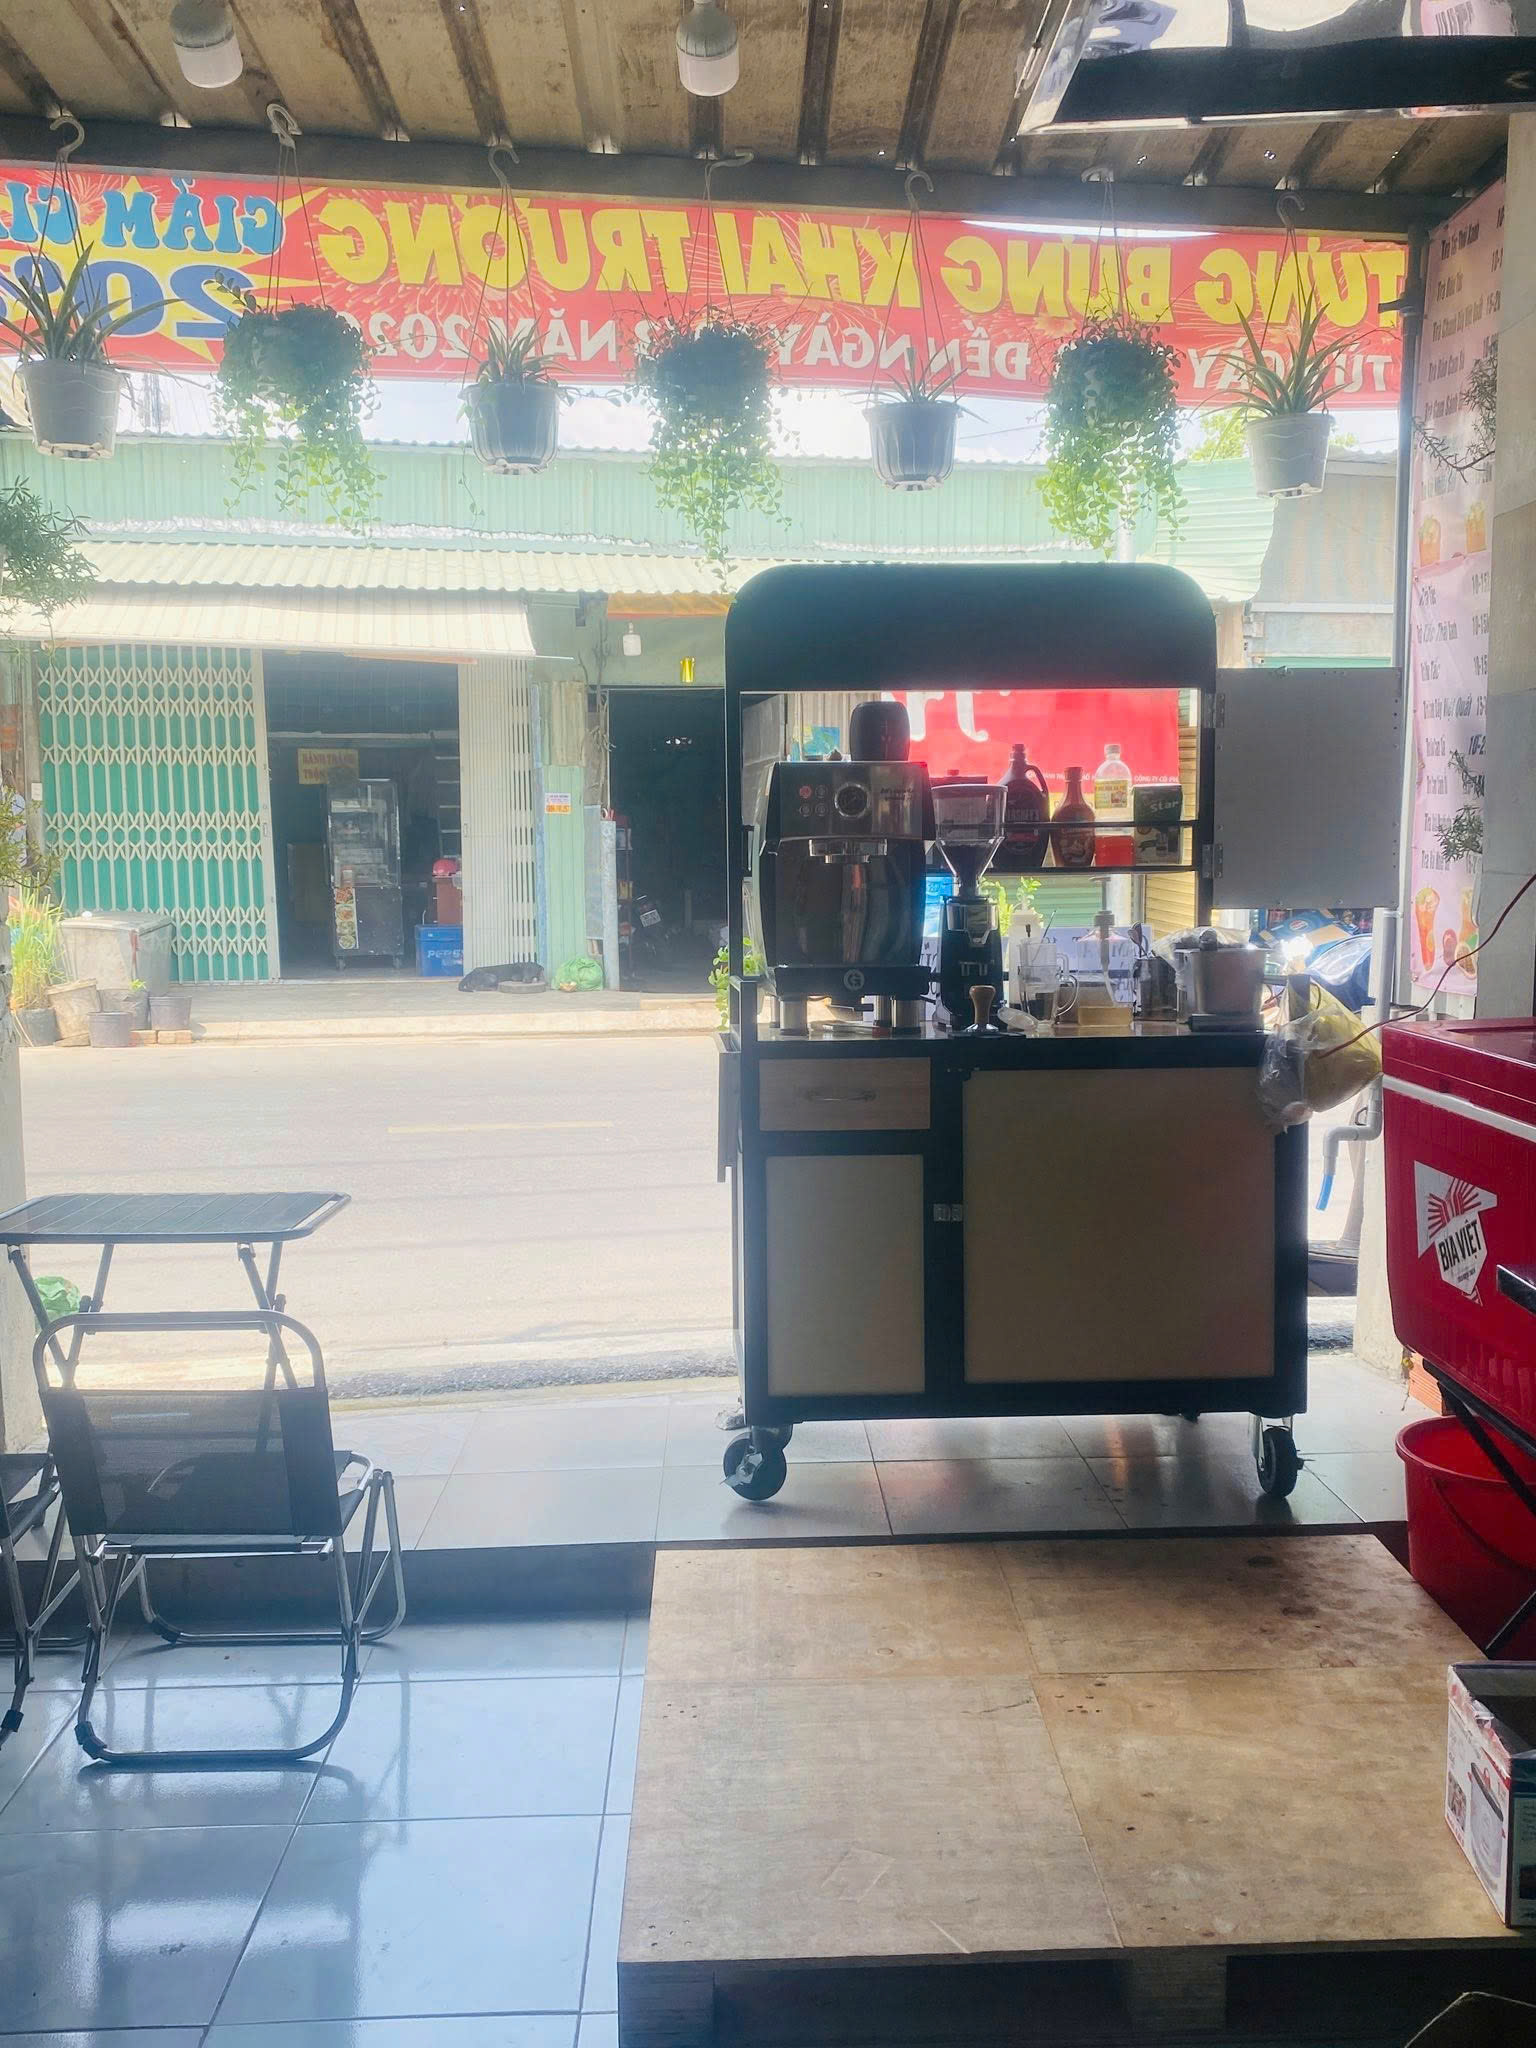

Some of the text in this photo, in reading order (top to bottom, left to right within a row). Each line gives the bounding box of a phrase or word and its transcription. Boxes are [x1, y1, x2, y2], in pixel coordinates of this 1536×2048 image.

[427, 949, 464, 959] PEPS
[1438, 1218, 1483, 1272] BIA VIỆT
